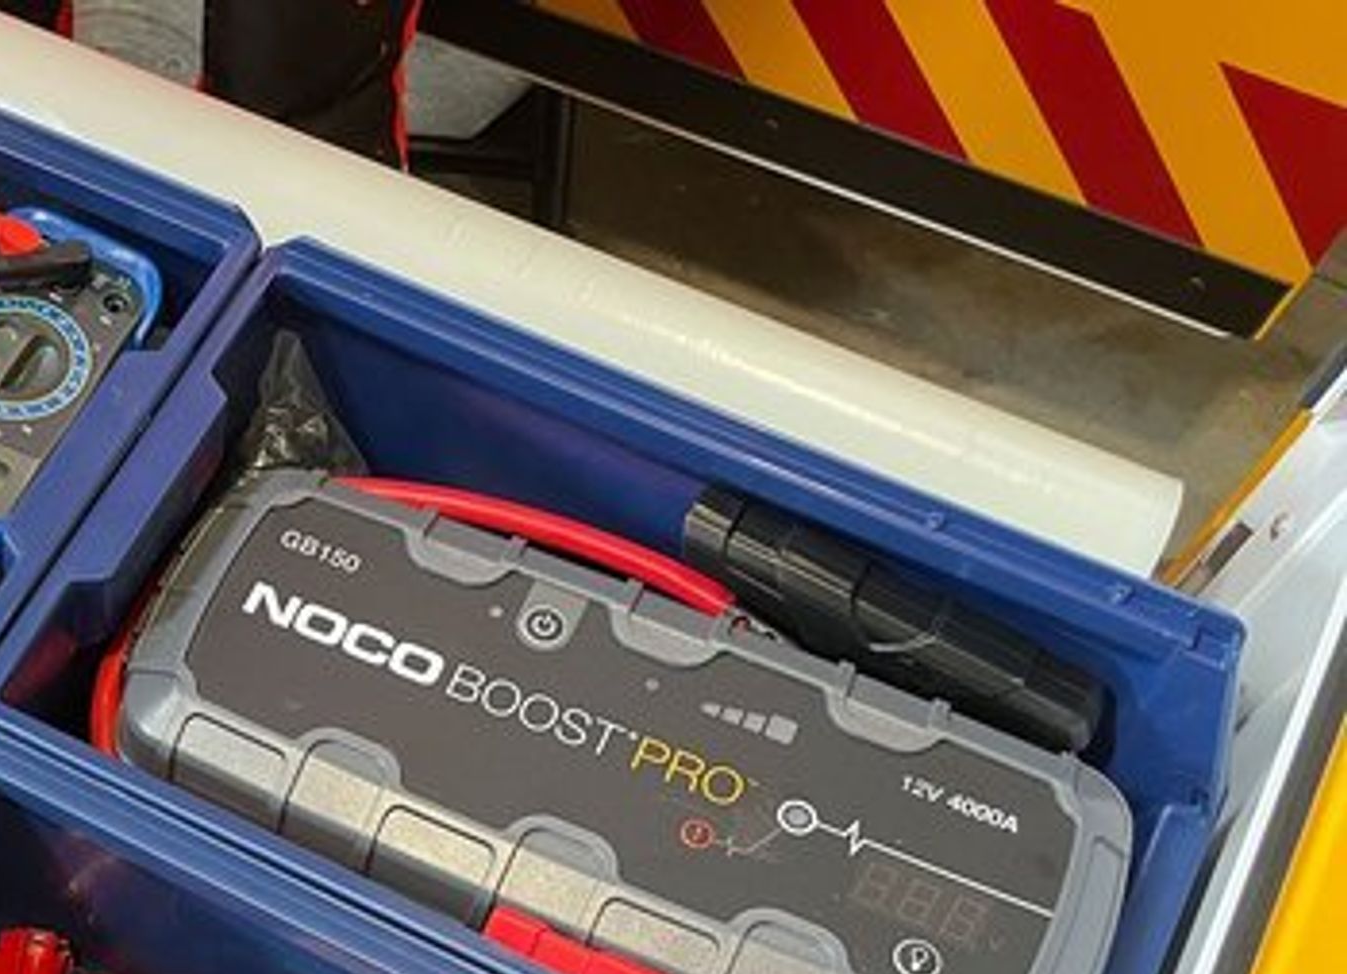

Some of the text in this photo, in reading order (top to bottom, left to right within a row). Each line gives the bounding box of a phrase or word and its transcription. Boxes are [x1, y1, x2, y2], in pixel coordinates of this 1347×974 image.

[279, 529, 363, 573] GB150
[241, 580, 745, 806] NOCO BOOST PRO
[901, 775, 1019, 834] 12V 4000A
